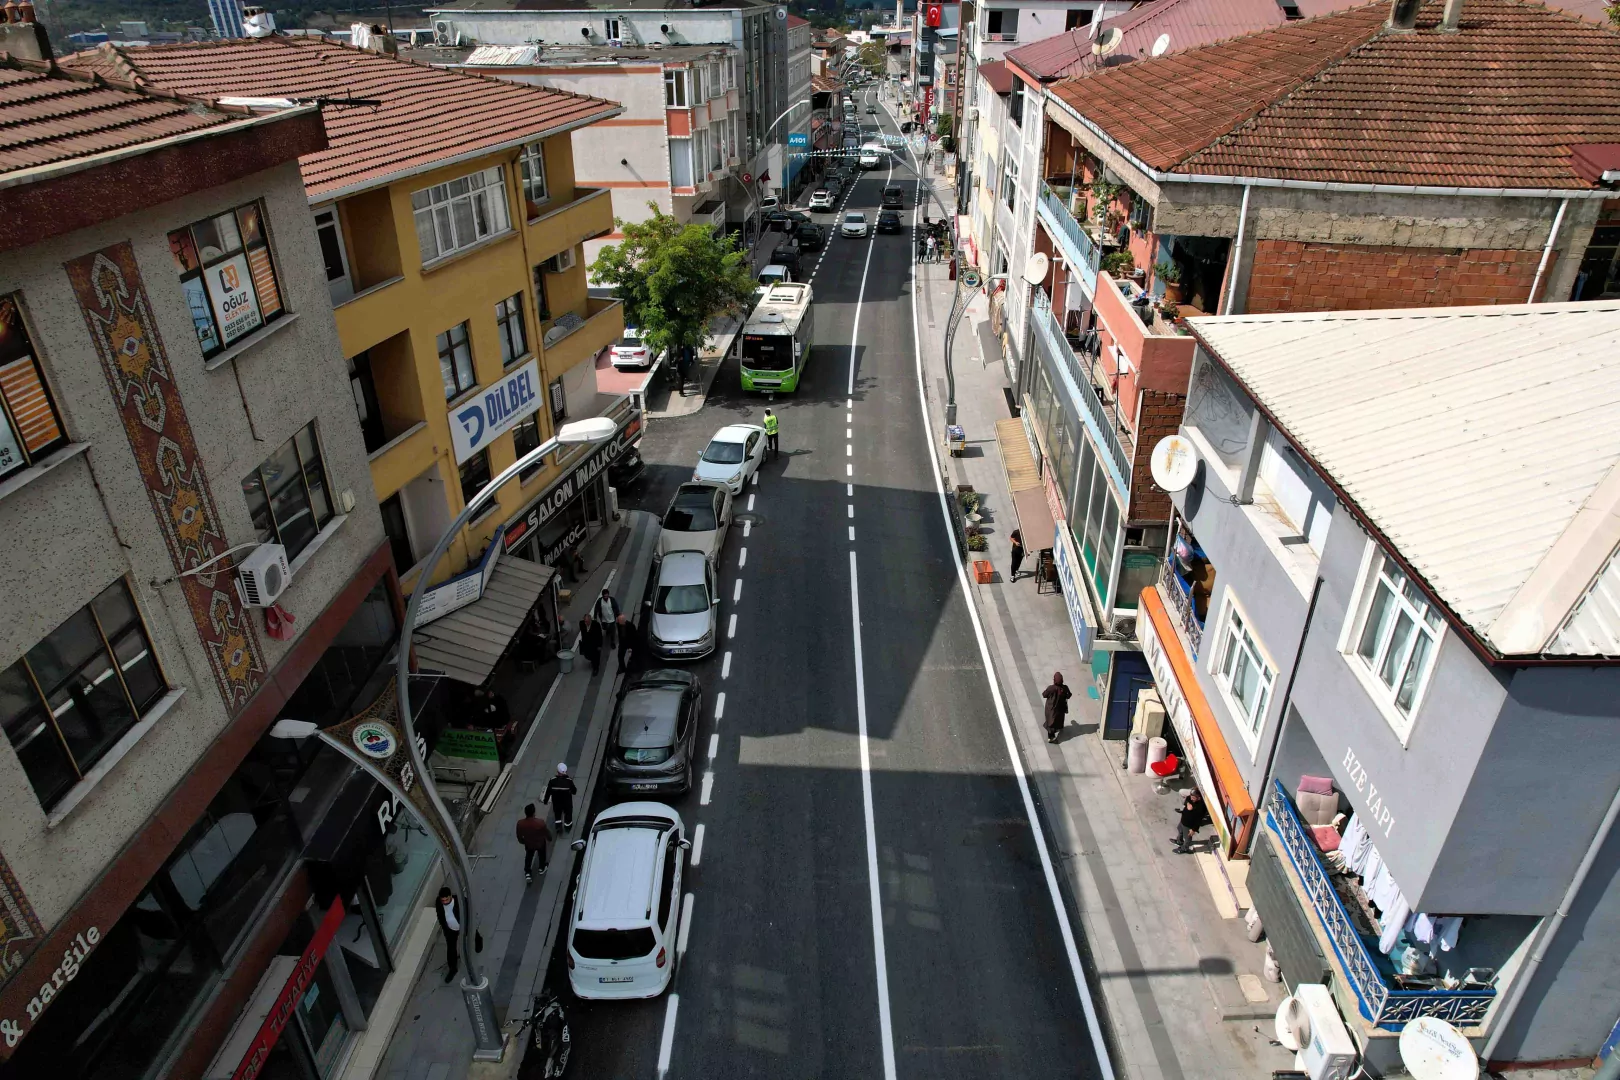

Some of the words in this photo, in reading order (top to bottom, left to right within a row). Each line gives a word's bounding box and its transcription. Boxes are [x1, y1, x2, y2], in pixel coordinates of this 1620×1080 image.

[222, 292, 249, 313] OĞUZ
[484, 370, 536, 428] DİLBEL
[2, 456, 12, 466] 04
[528, 478, 574, 530] SALON
[576, 432, 624, 490] İNALKOÇ
[544, 524, 580, 566] İNALKOÇ
[1148, 636, 1184, 720] Motif
[1366, 782, 1396, 838] YAPI
[0, 1019, 24, 1047] &
[26, 926, 100, 1021] nargile
[270, 948, 320, 1034] TUHAFİYE
